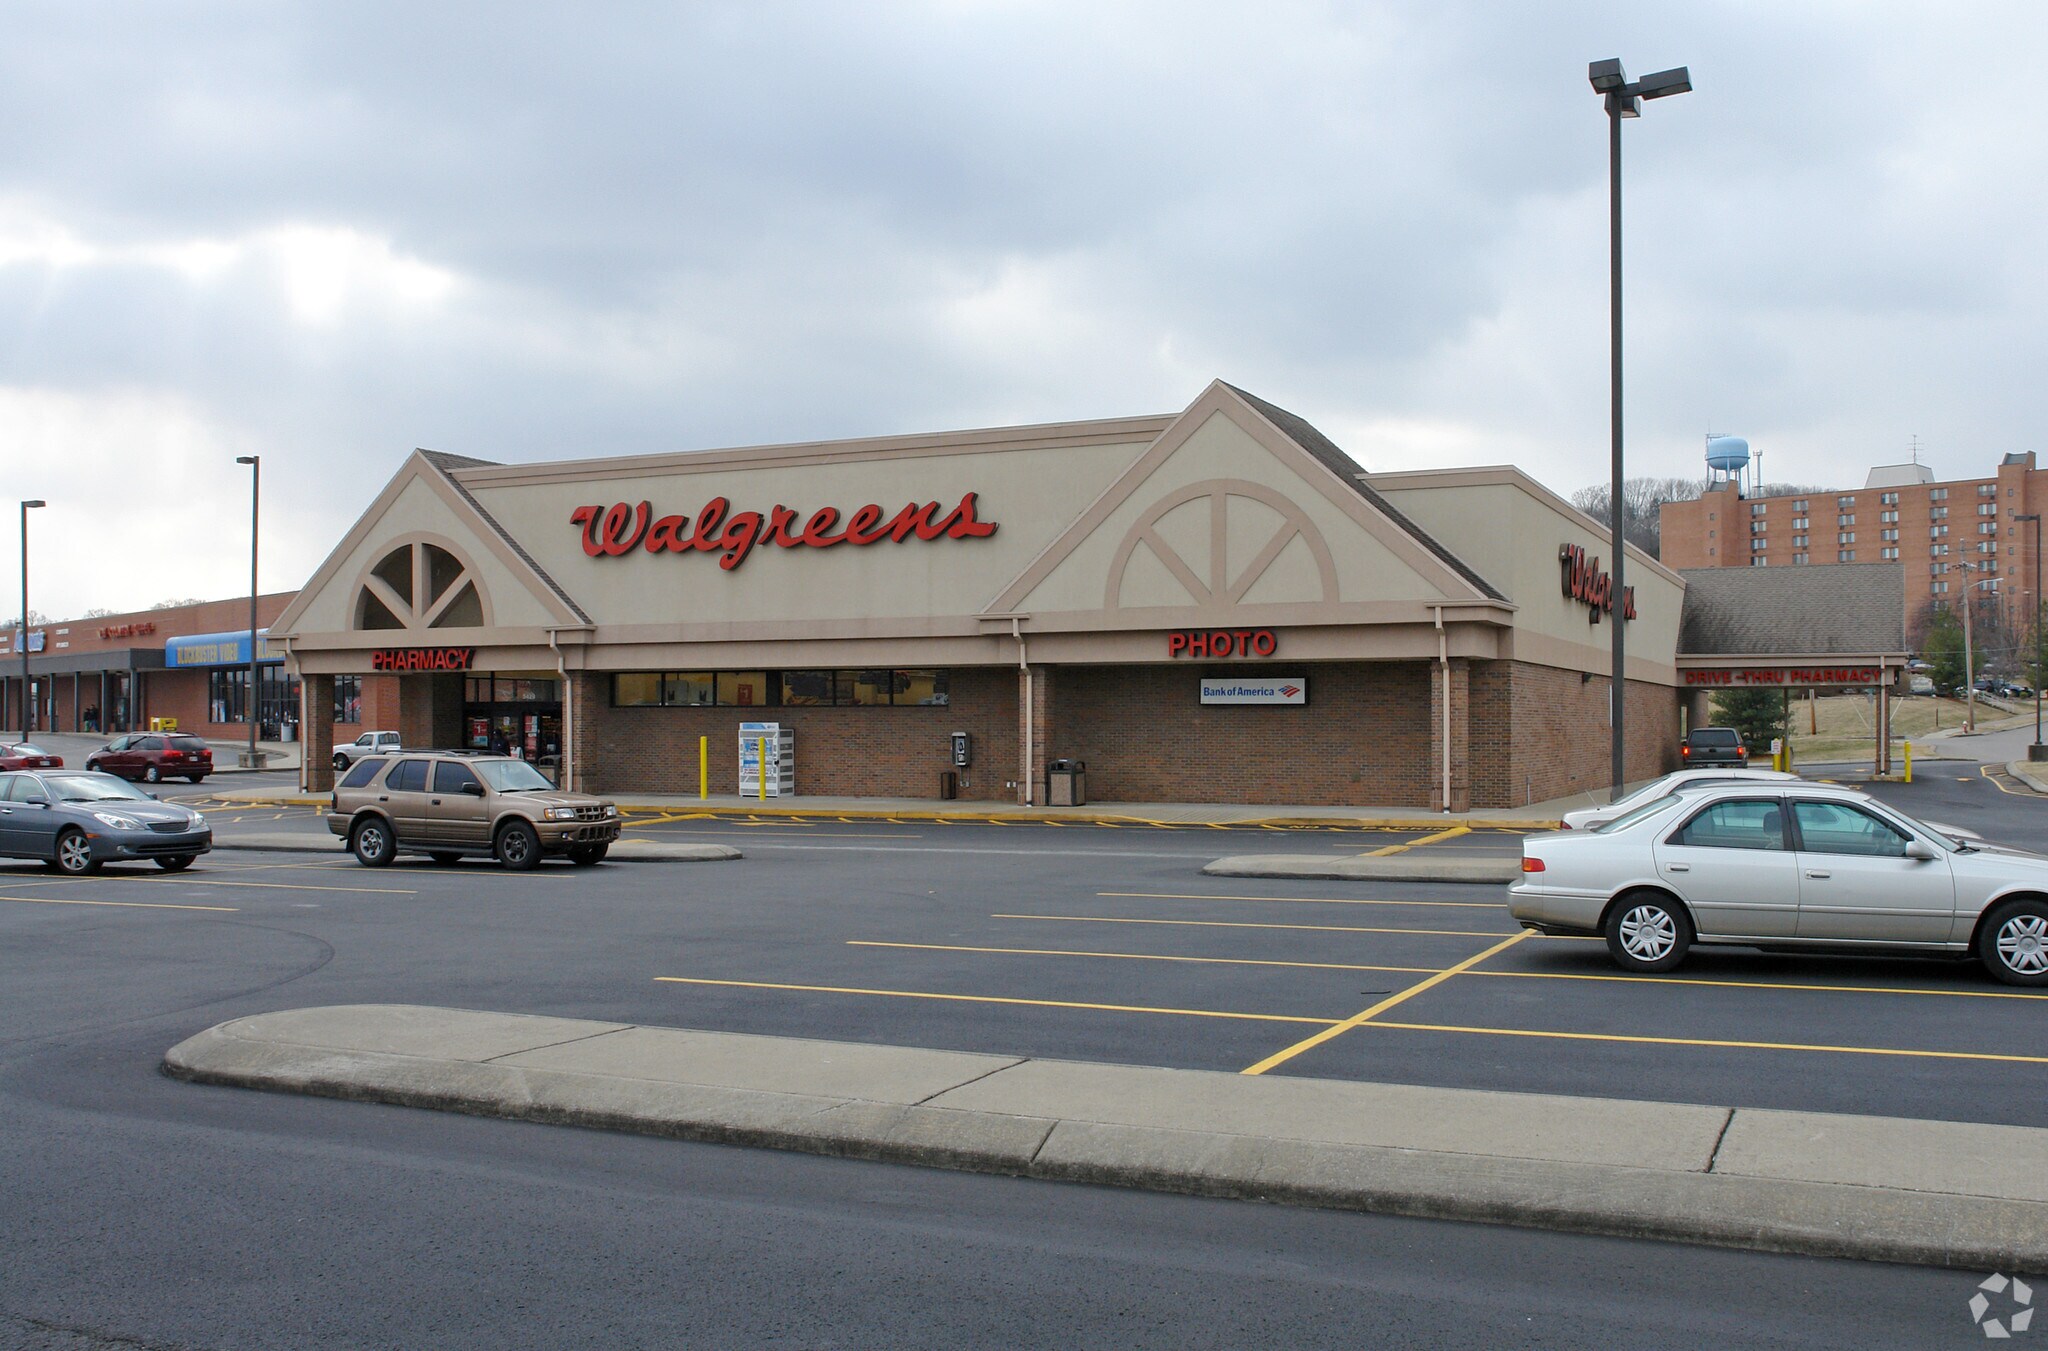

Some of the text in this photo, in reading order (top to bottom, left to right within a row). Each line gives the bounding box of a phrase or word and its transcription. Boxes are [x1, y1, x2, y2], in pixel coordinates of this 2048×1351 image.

[570, 492, 999, 571] Walgreens
[1168, 630, 1277, 657] PHOTO
[372, 649, 473, 670] PHARMACY
[1685, 671, 1732, 684] DRIVE
[1790, 668, 1881, 682] PHARMACY
[1203, 685, 1274, 696] Bank of America
